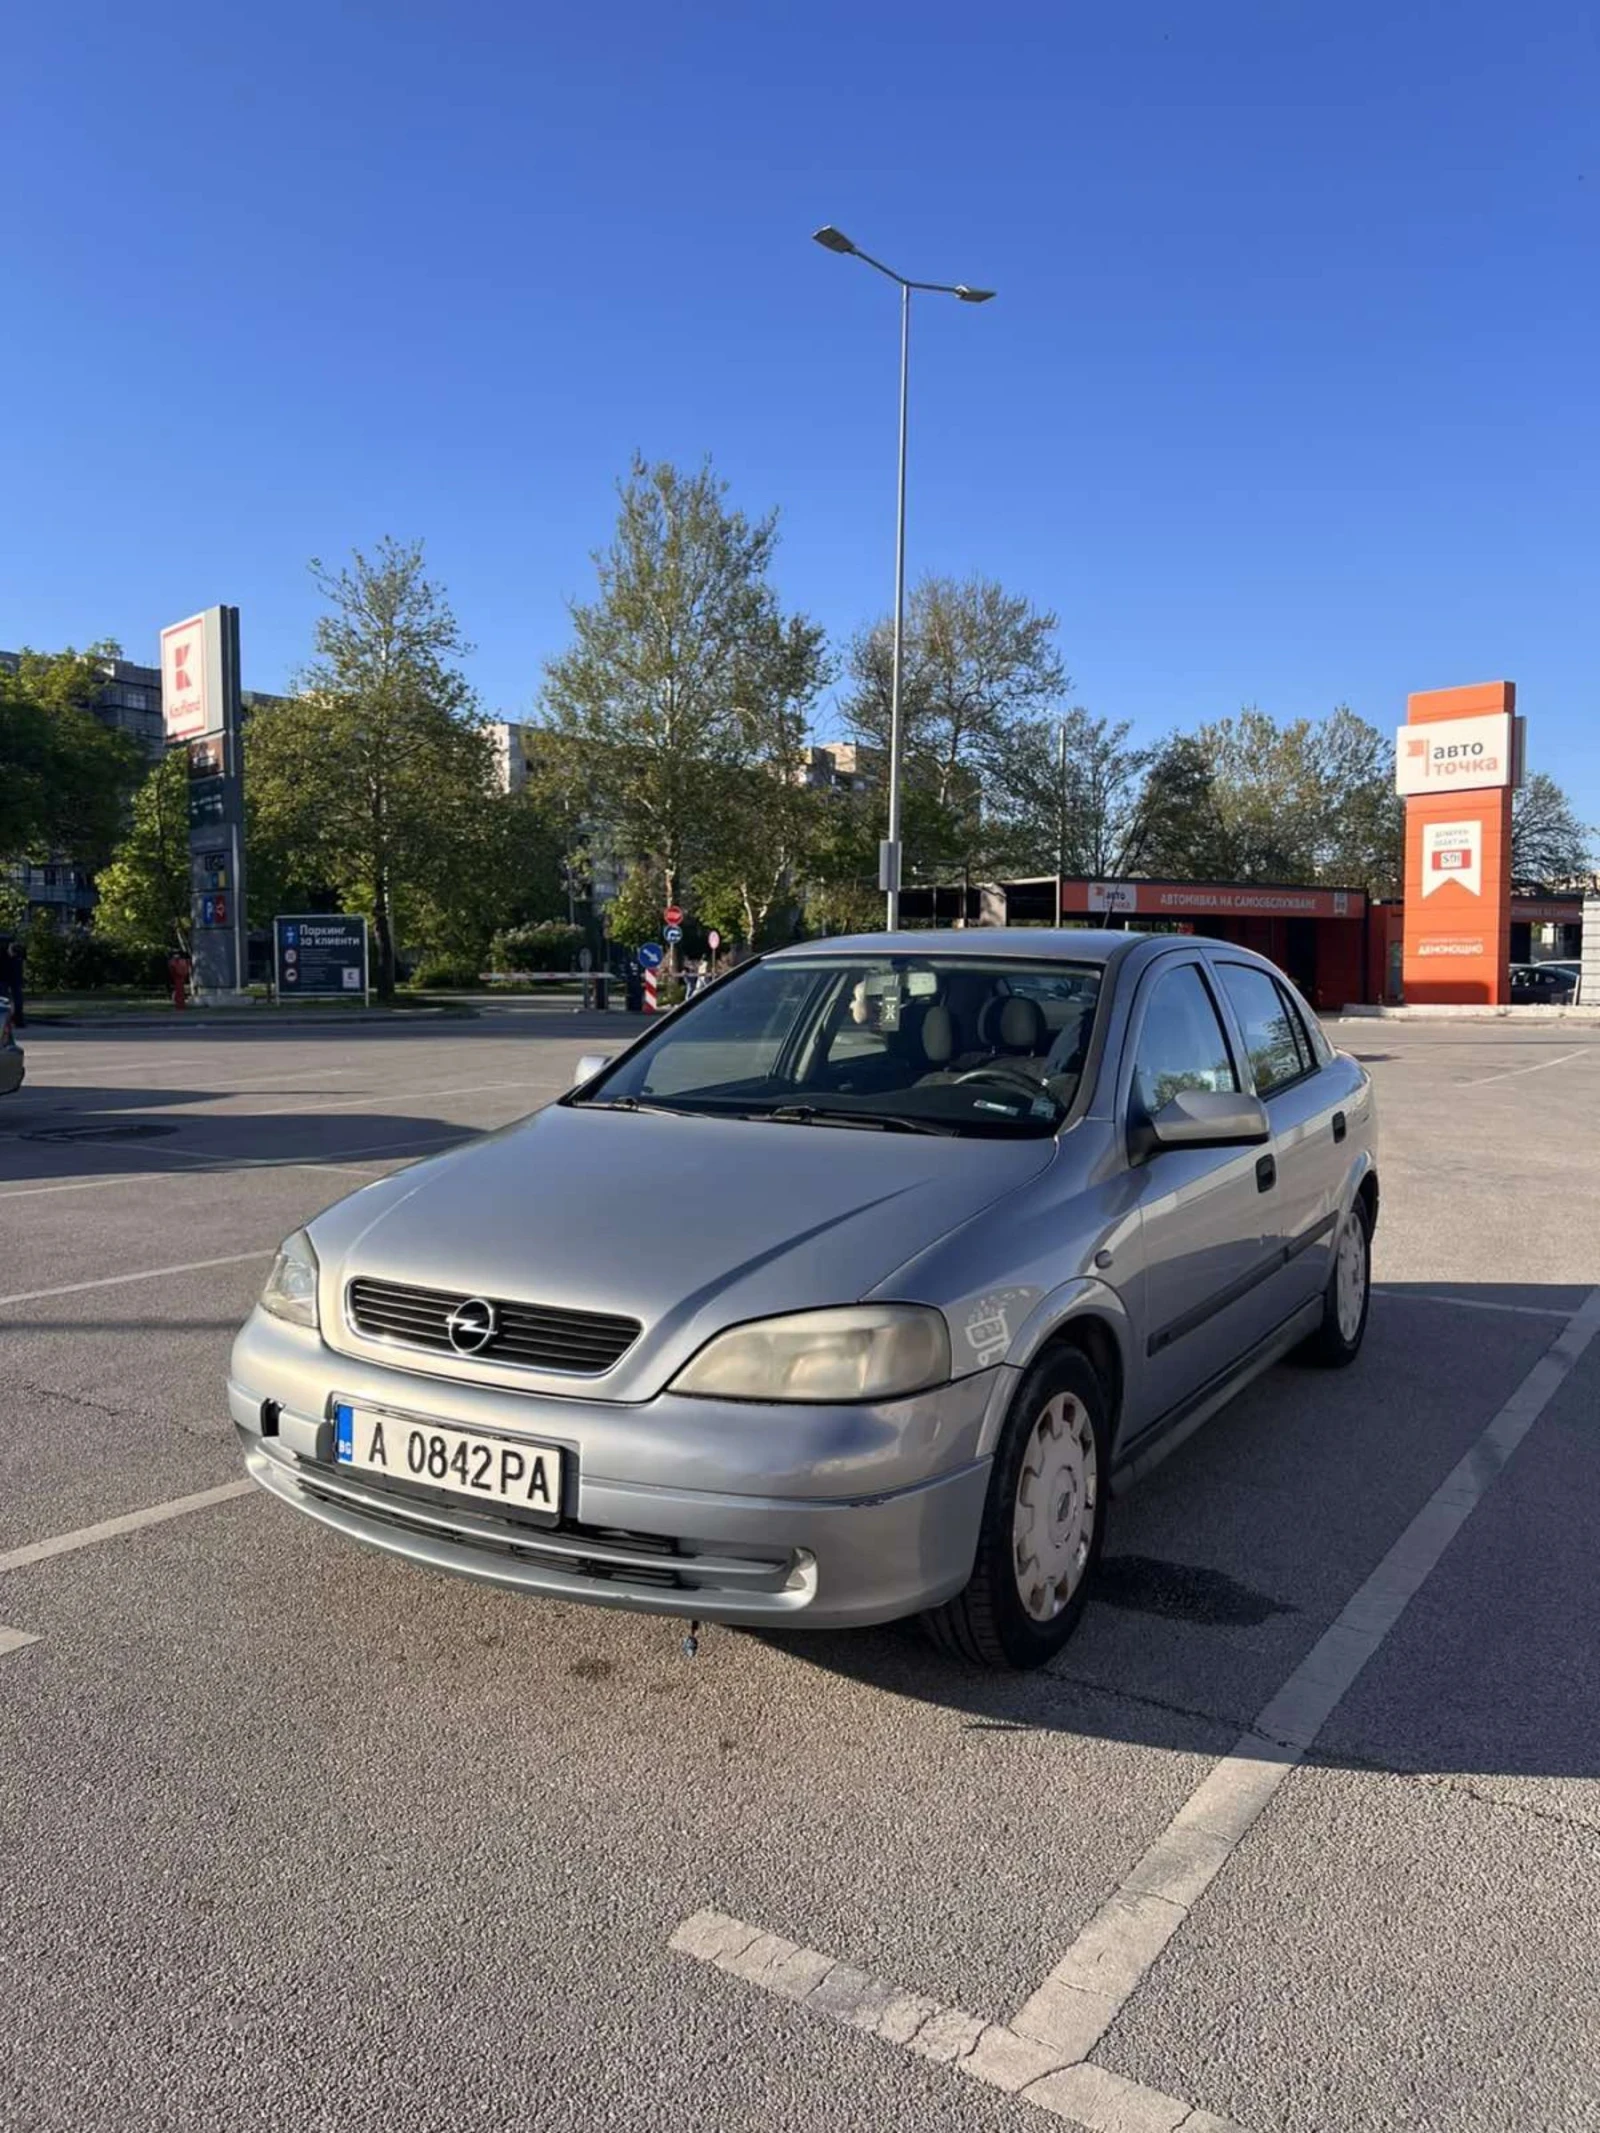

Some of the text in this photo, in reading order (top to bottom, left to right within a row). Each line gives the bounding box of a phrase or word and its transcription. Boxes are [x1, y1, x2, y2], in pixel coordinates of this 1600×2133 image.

[1434, 742, 1484, 760] авто
[1434, 757, 1498, 776] точка
[1219, 896, 1233, 908] НА
[300, 924, 346, 936] Паркинг
[300, 937, 360, 946] за клиенти
[338, 1439, 352, 1454] BG
[369, 1421, 552, 1504] A 0842PA
